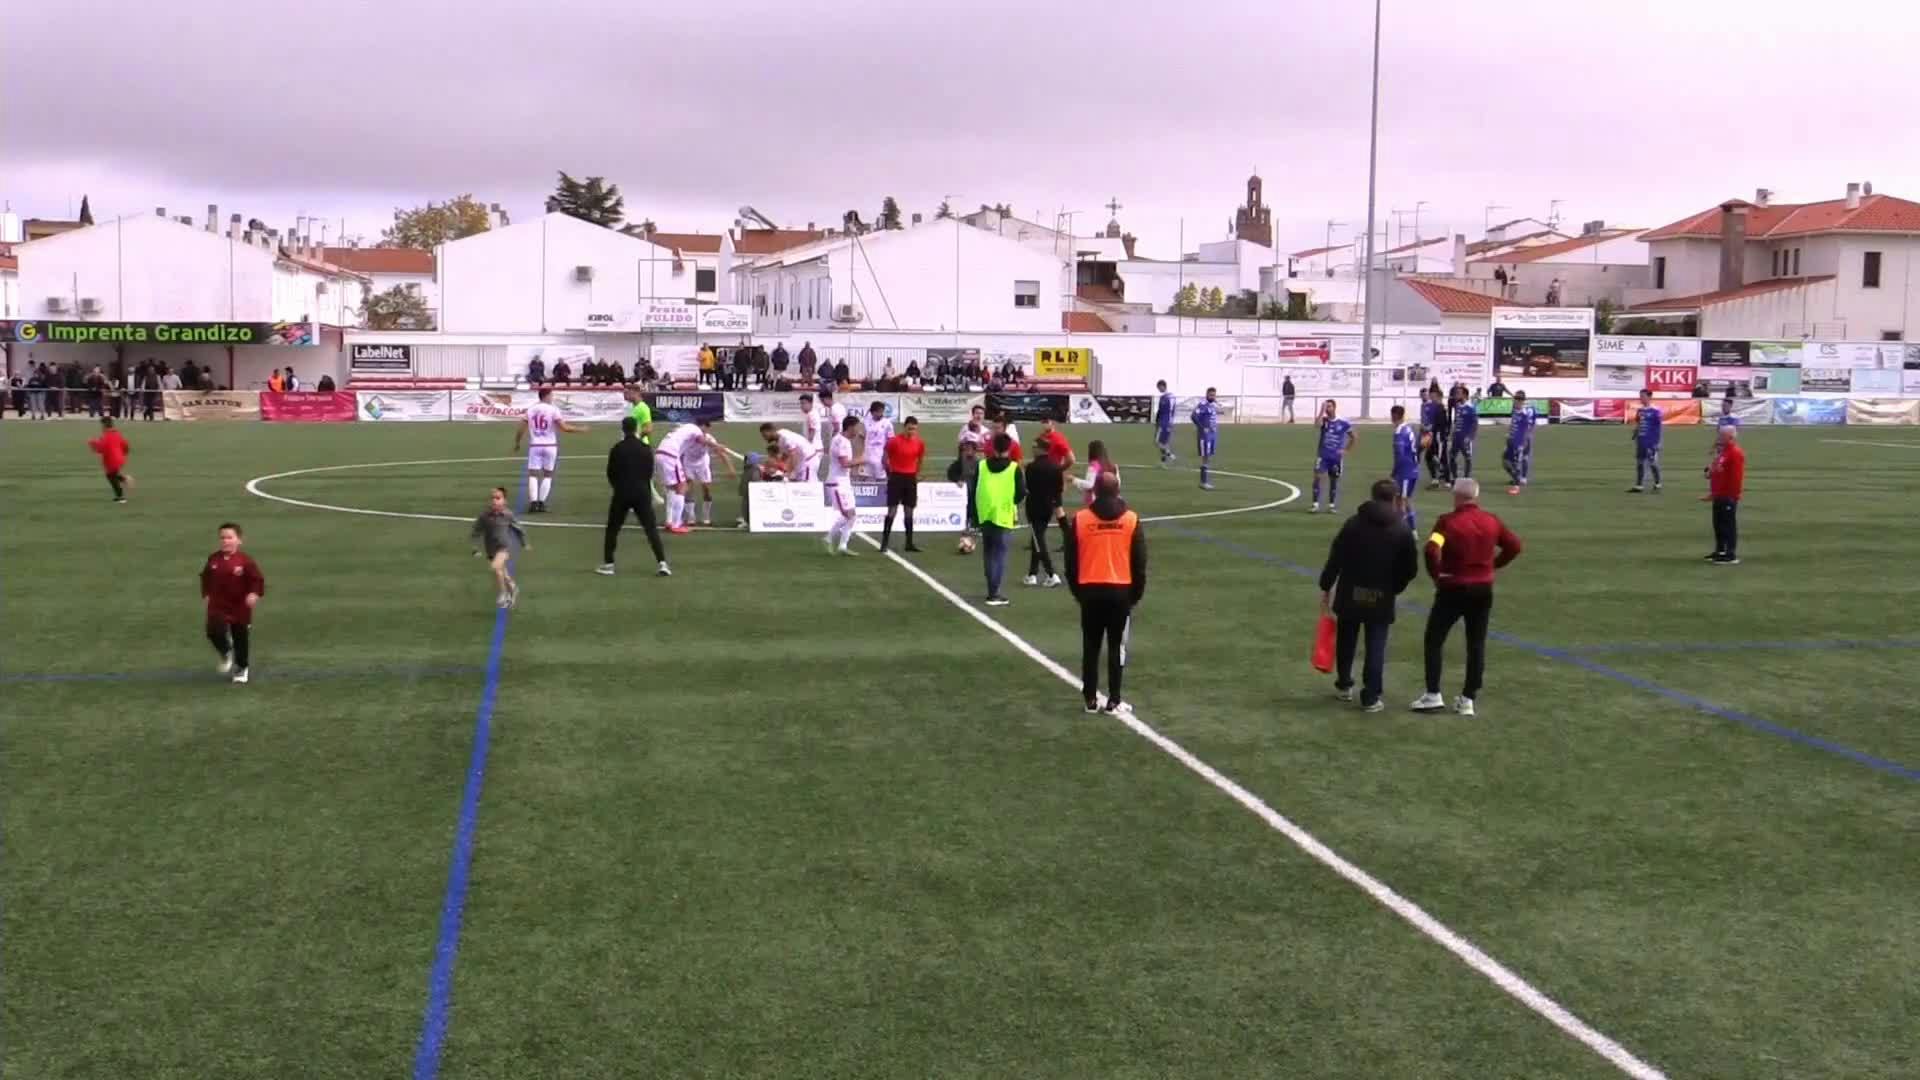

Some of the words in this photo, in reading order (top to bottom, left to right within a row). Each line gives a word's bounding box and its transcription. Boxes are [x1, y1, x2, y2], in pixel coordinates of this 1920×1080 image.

[48, 323, 147, 343] Imprenta
[155, 323, 252, 341] Grandizo
[354, 345, 404, 359] LabelNet
[1649, 370, 1693, 384] KIKI
[531, 415, 549, 431] 16
